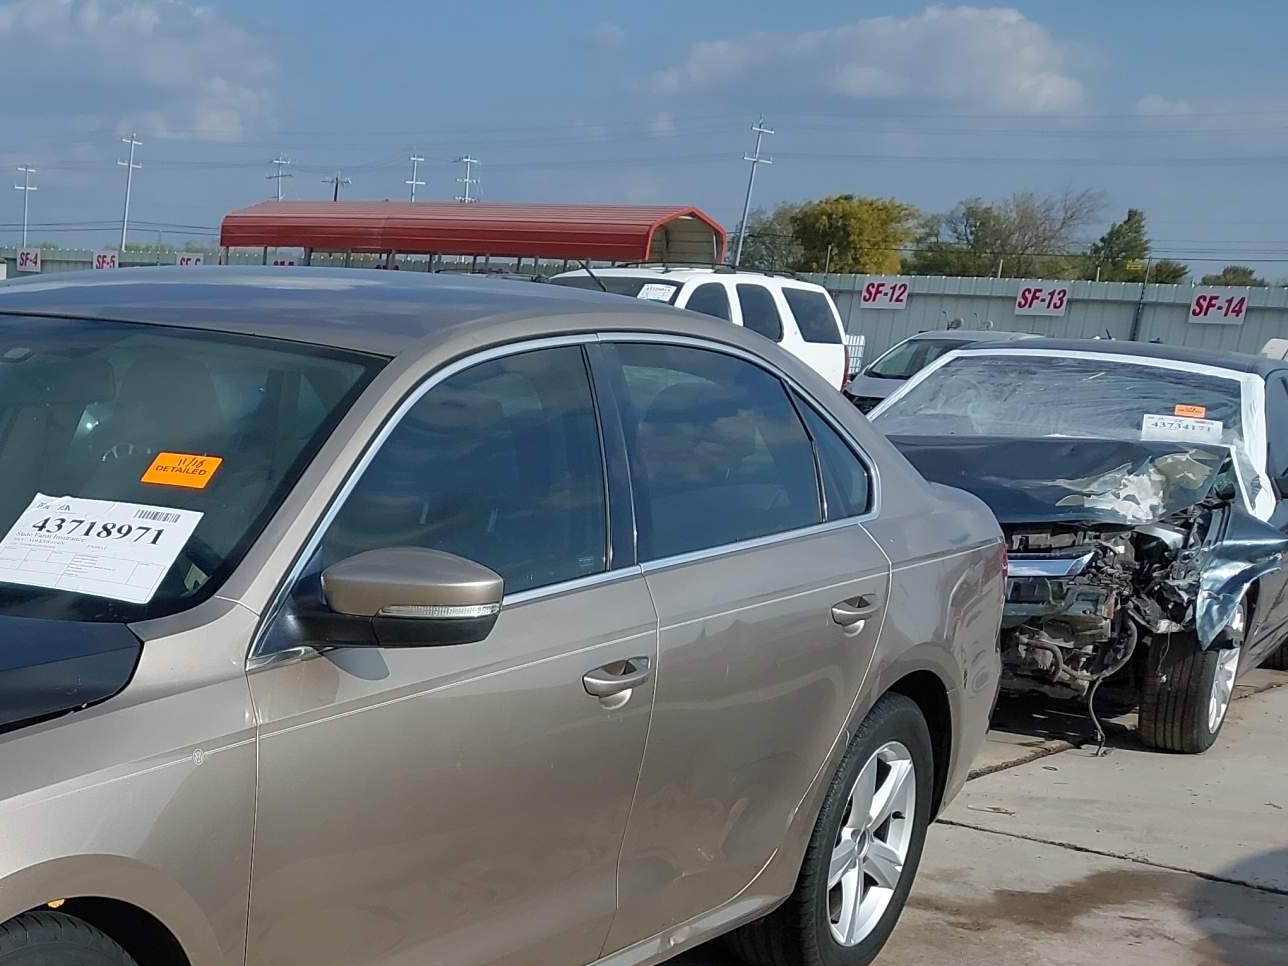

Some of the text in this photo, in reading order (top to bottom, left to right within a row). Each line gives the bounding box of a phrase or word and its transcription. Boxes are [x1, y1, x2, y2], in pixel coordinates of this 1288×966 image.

[19, 251, 38, 267] SF-4
[95, 254, 116, 269] SF-5
[862, 282, 908, 303] SF-12
[1016, 287, 1067, 310] SF-13
[1191, 294, 1246, 317] SF-14
[154, 464, 207, 476] DETAILED
[32, 516, 165, 545] 43718971
